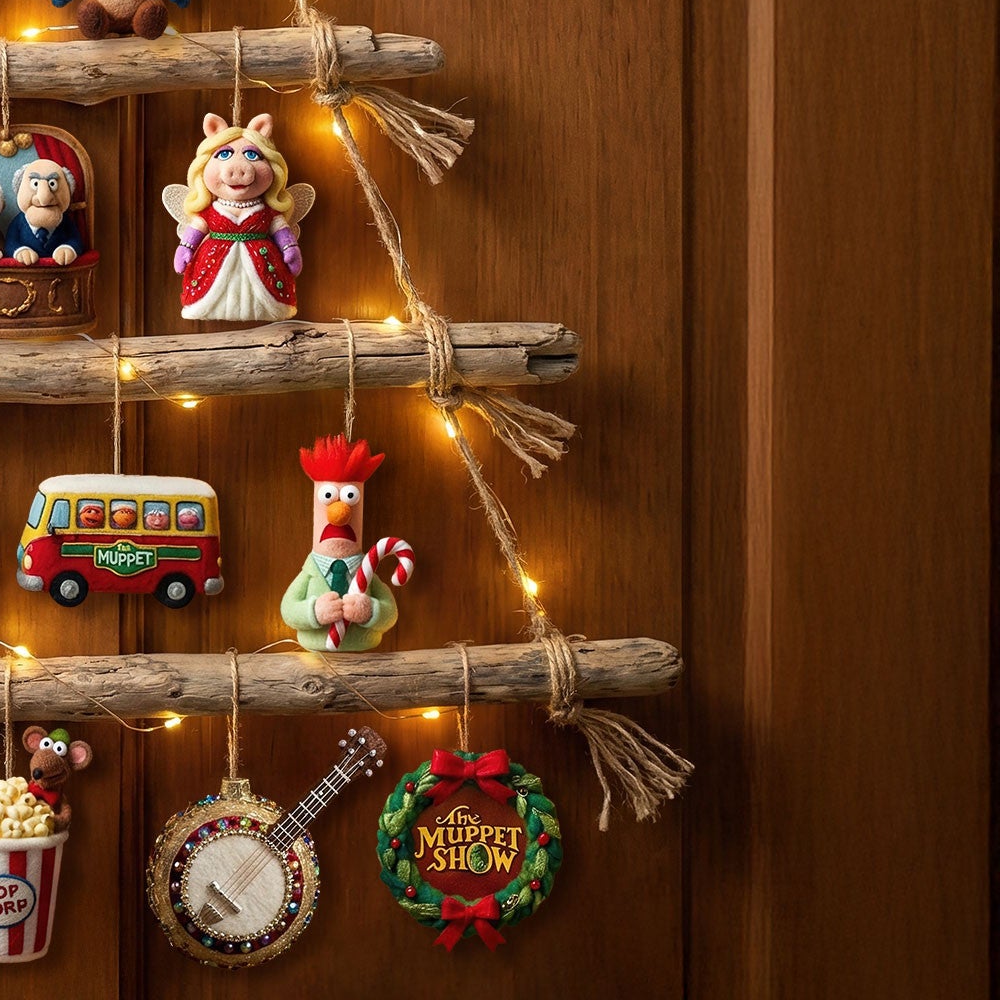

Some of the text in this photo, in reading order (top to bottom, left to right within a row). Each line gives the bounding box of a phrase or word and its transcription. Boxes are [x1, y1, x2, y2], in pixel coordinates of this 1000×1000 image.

[98, 549, 153, 567] MUPPET
[436, 805, 481, 825] The
[415, 825, 522, 859] MUPPET
[427, 842, 518, 874] SHOW
